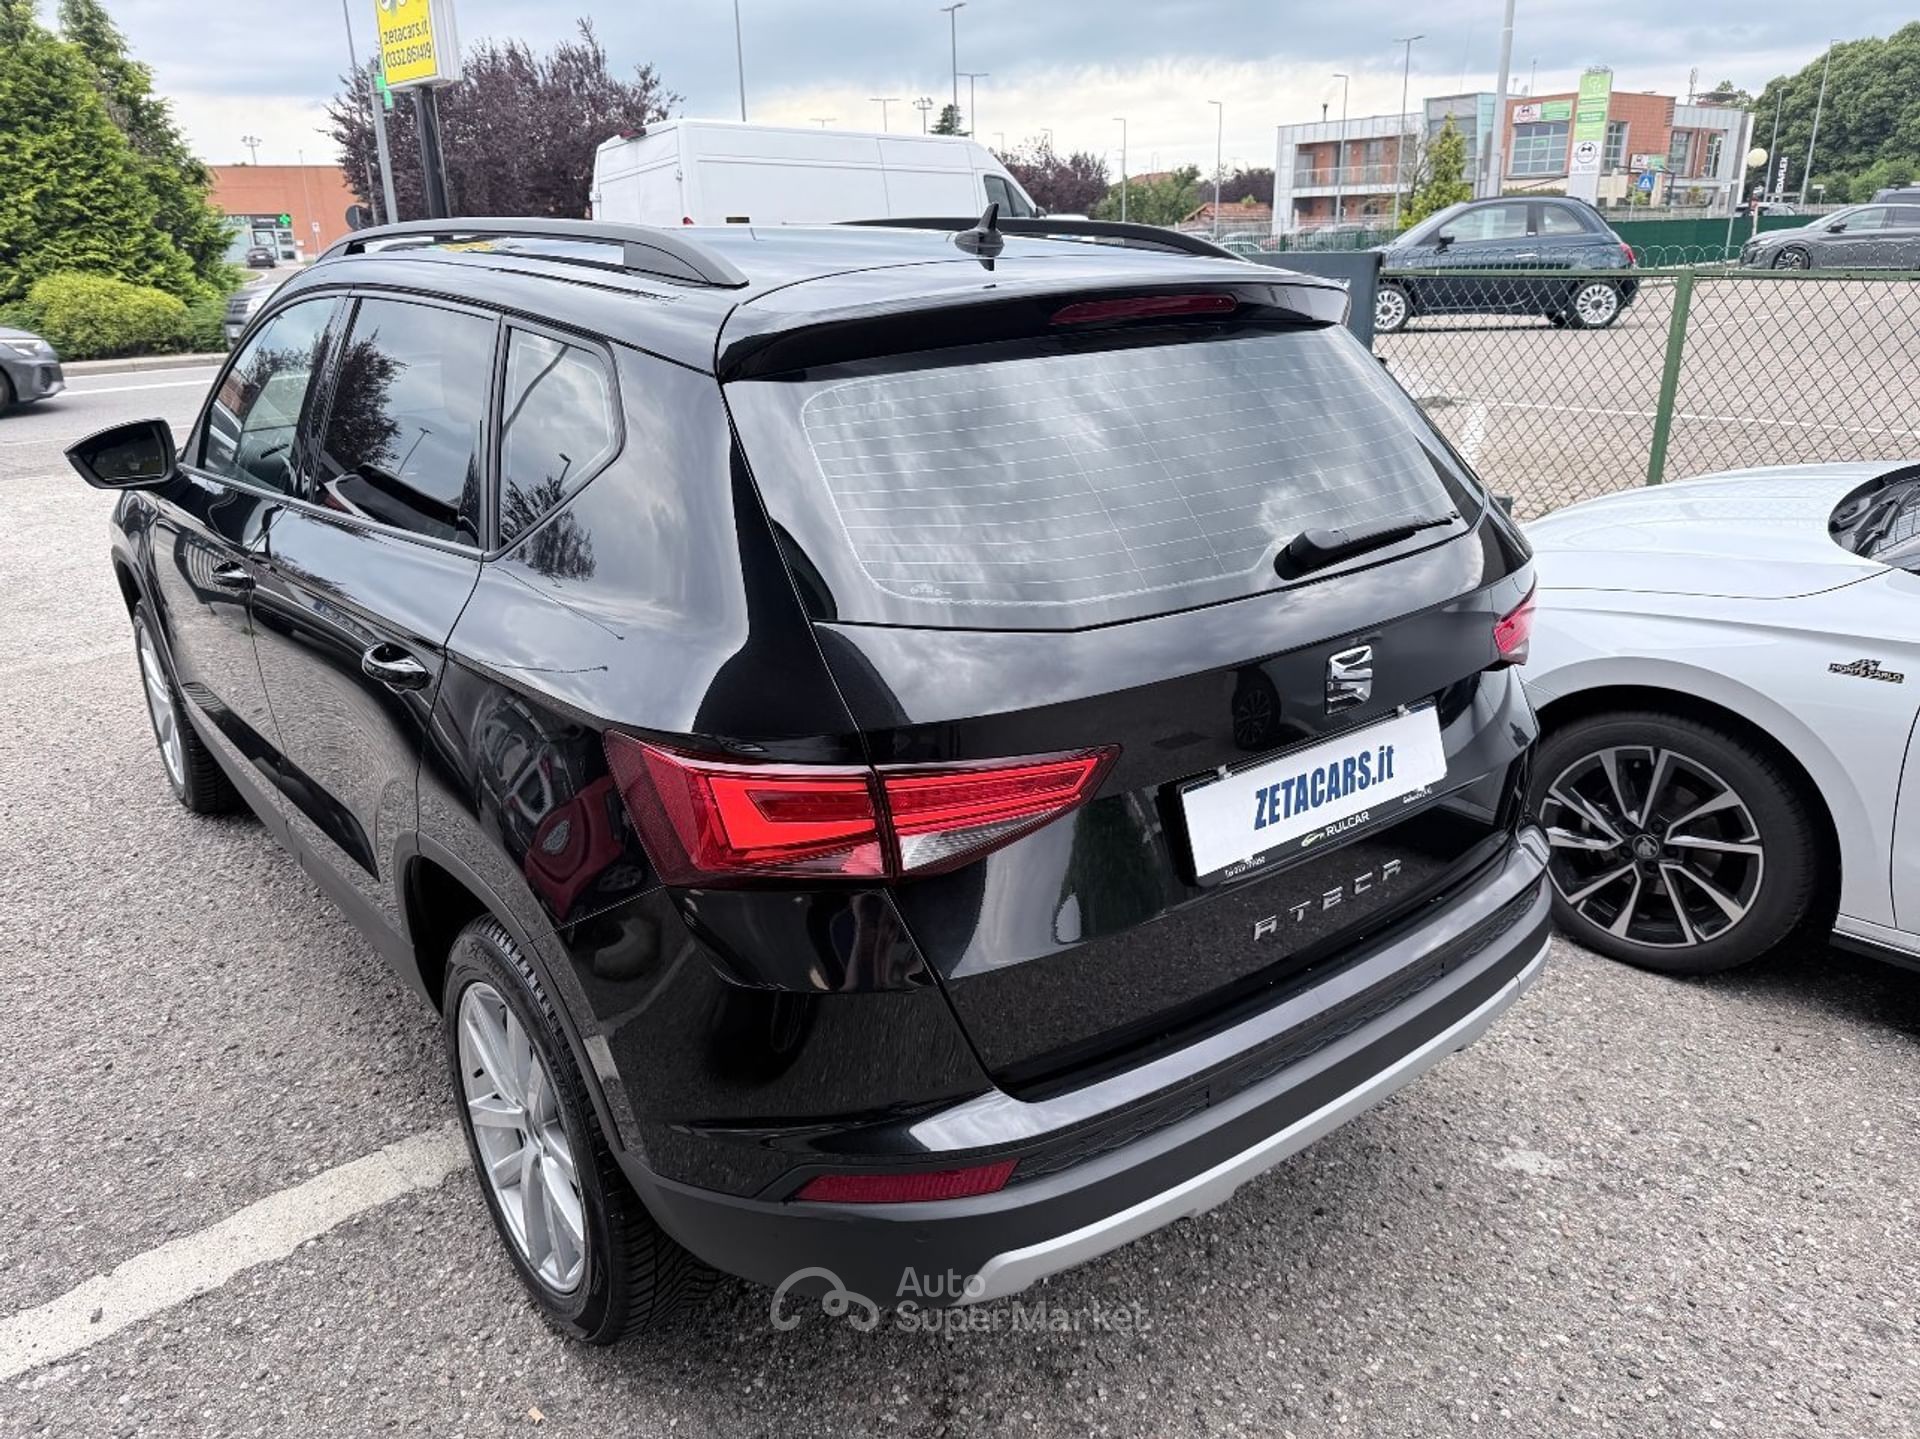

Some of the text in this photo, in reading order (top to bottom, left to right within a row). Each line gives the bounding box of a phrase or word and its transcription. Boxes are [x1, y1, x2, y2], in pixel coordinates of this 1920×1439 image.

[383, 16, 429, 45] zetacars.it
[1254, 745, 1394, 830] ZETACARS.it
[1325, 811, 1370, 837] RULCAR
[1254, 859, 1401, 941] ATECA
